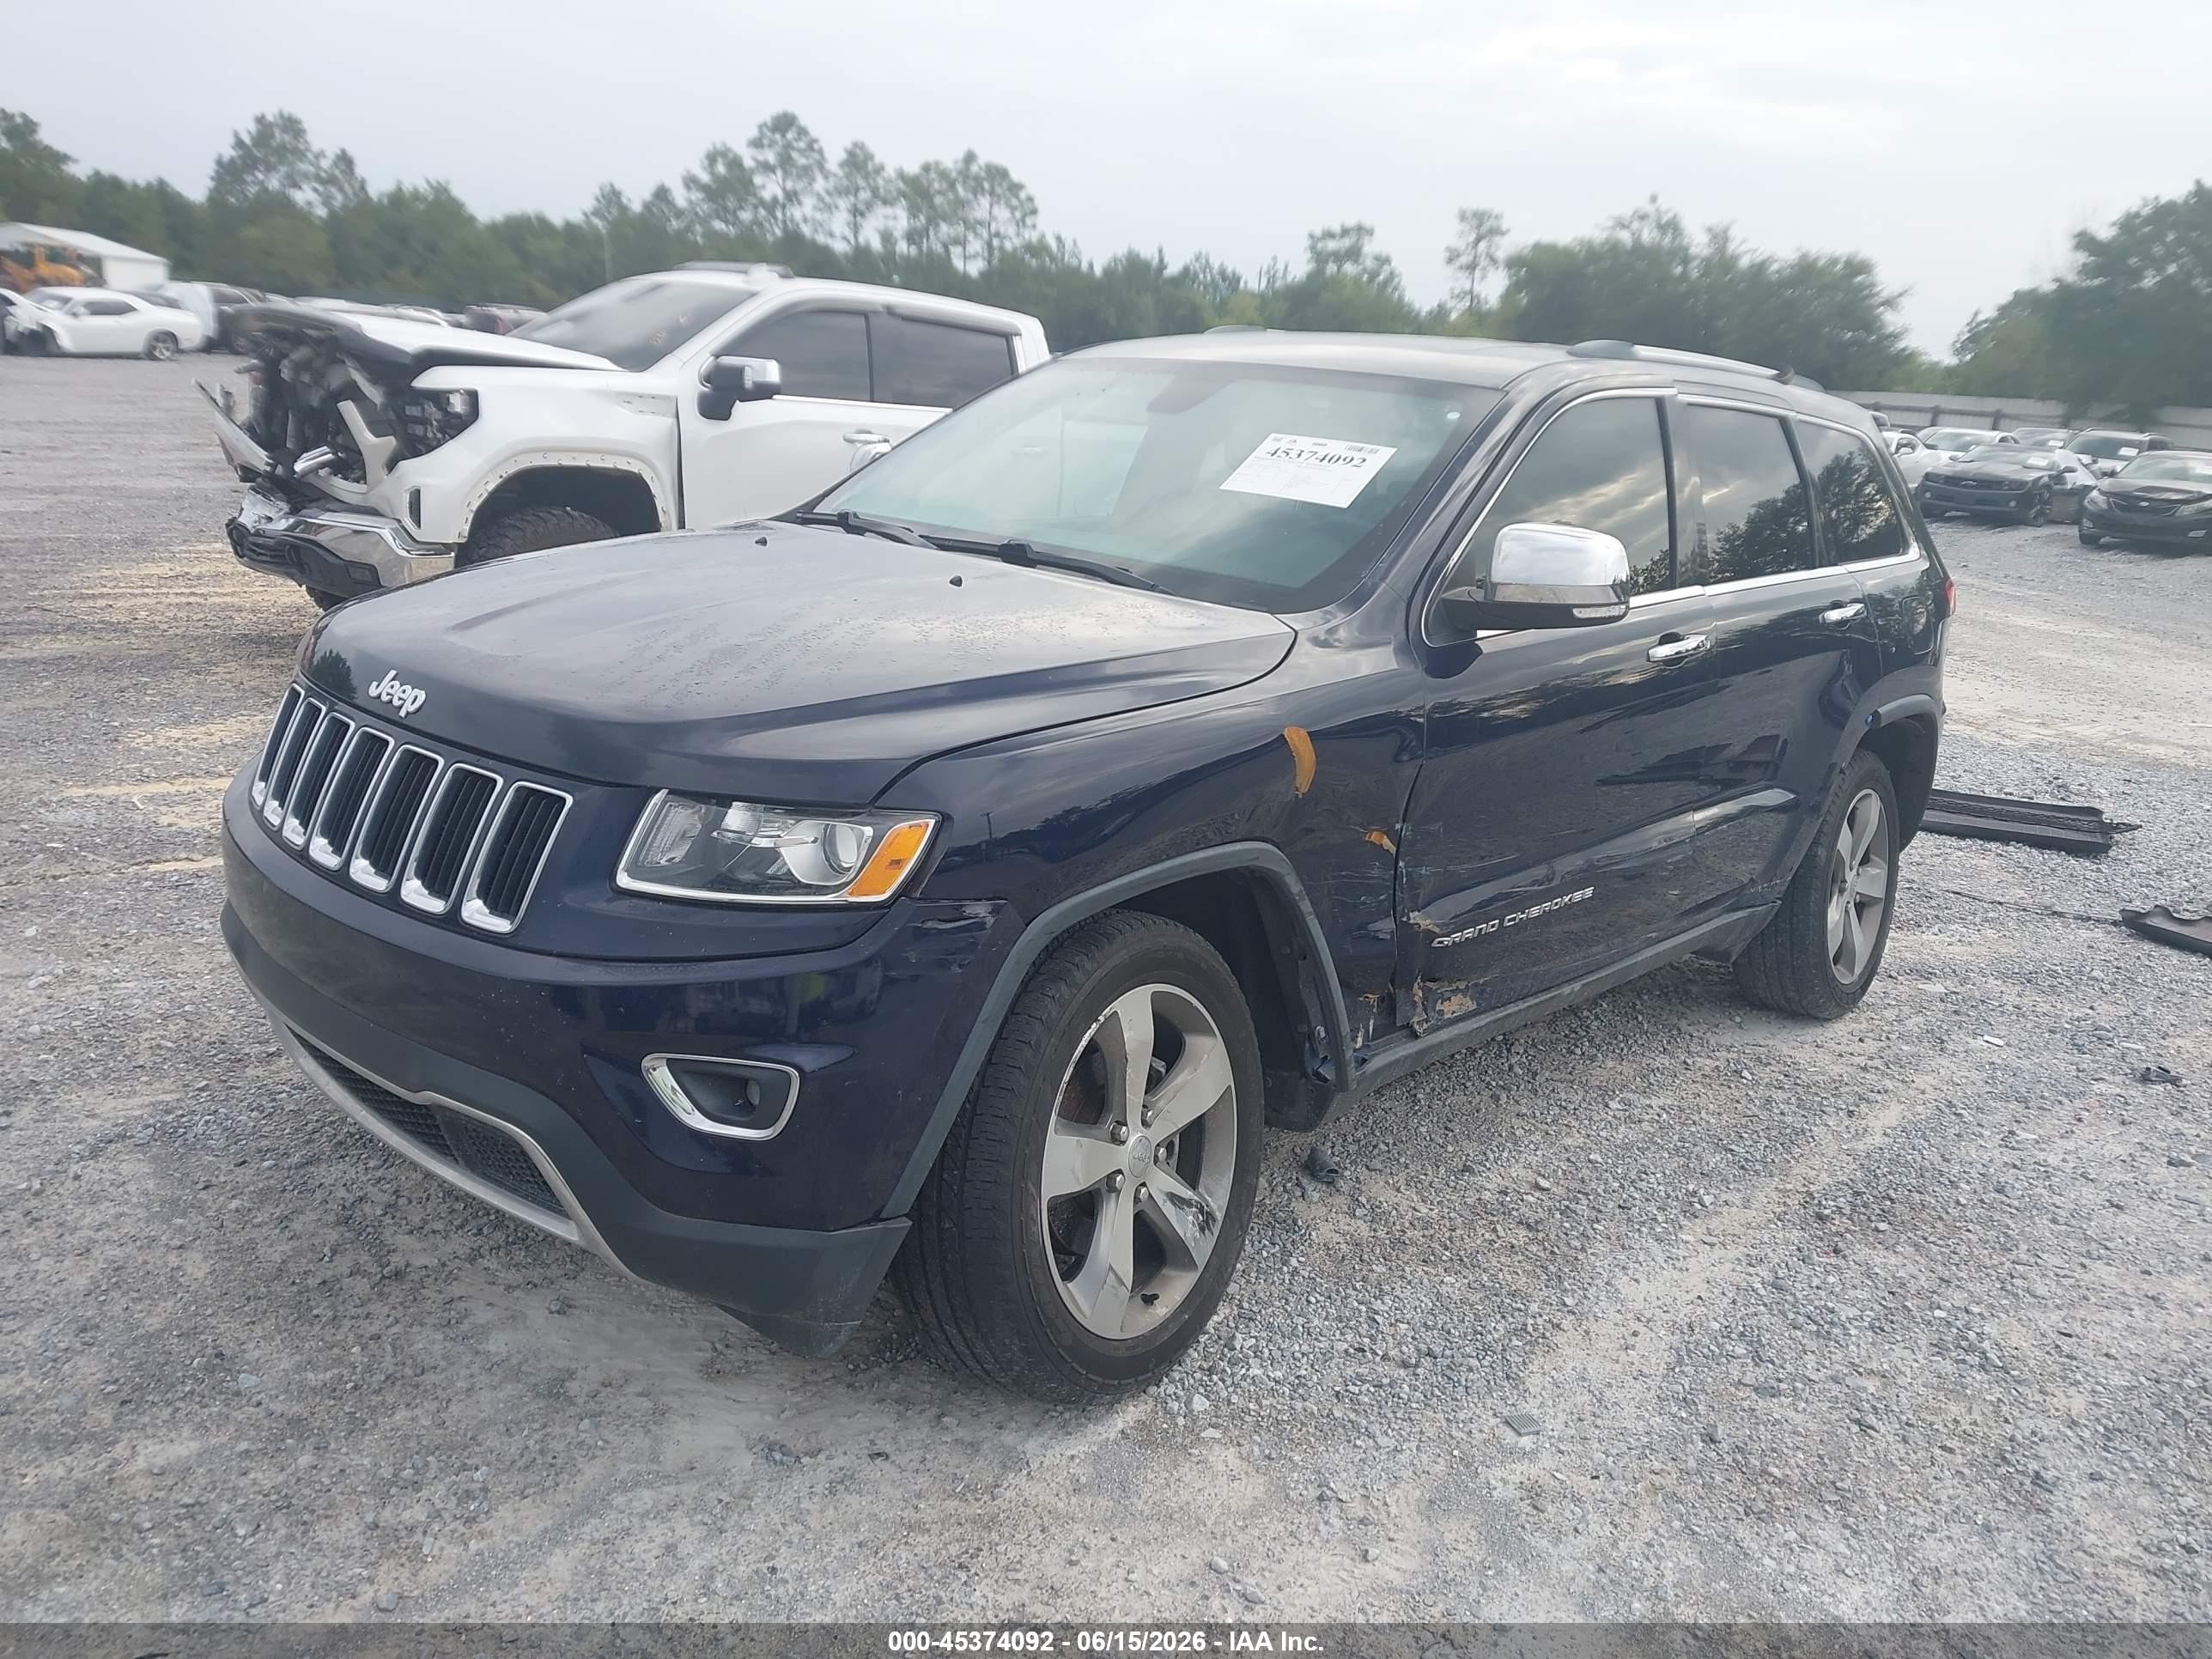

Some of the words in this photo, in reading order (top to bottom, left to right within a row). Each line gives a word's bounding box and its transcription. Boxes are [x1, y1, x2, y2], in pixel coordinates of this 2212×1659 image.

[1266, 446, 1368, 469] 45374092
[368, 669, 427, 719] Jeep
[1430, 919, 1500, 948] GRAND
[1503, 886, 1595, 928] CHEROKEE
